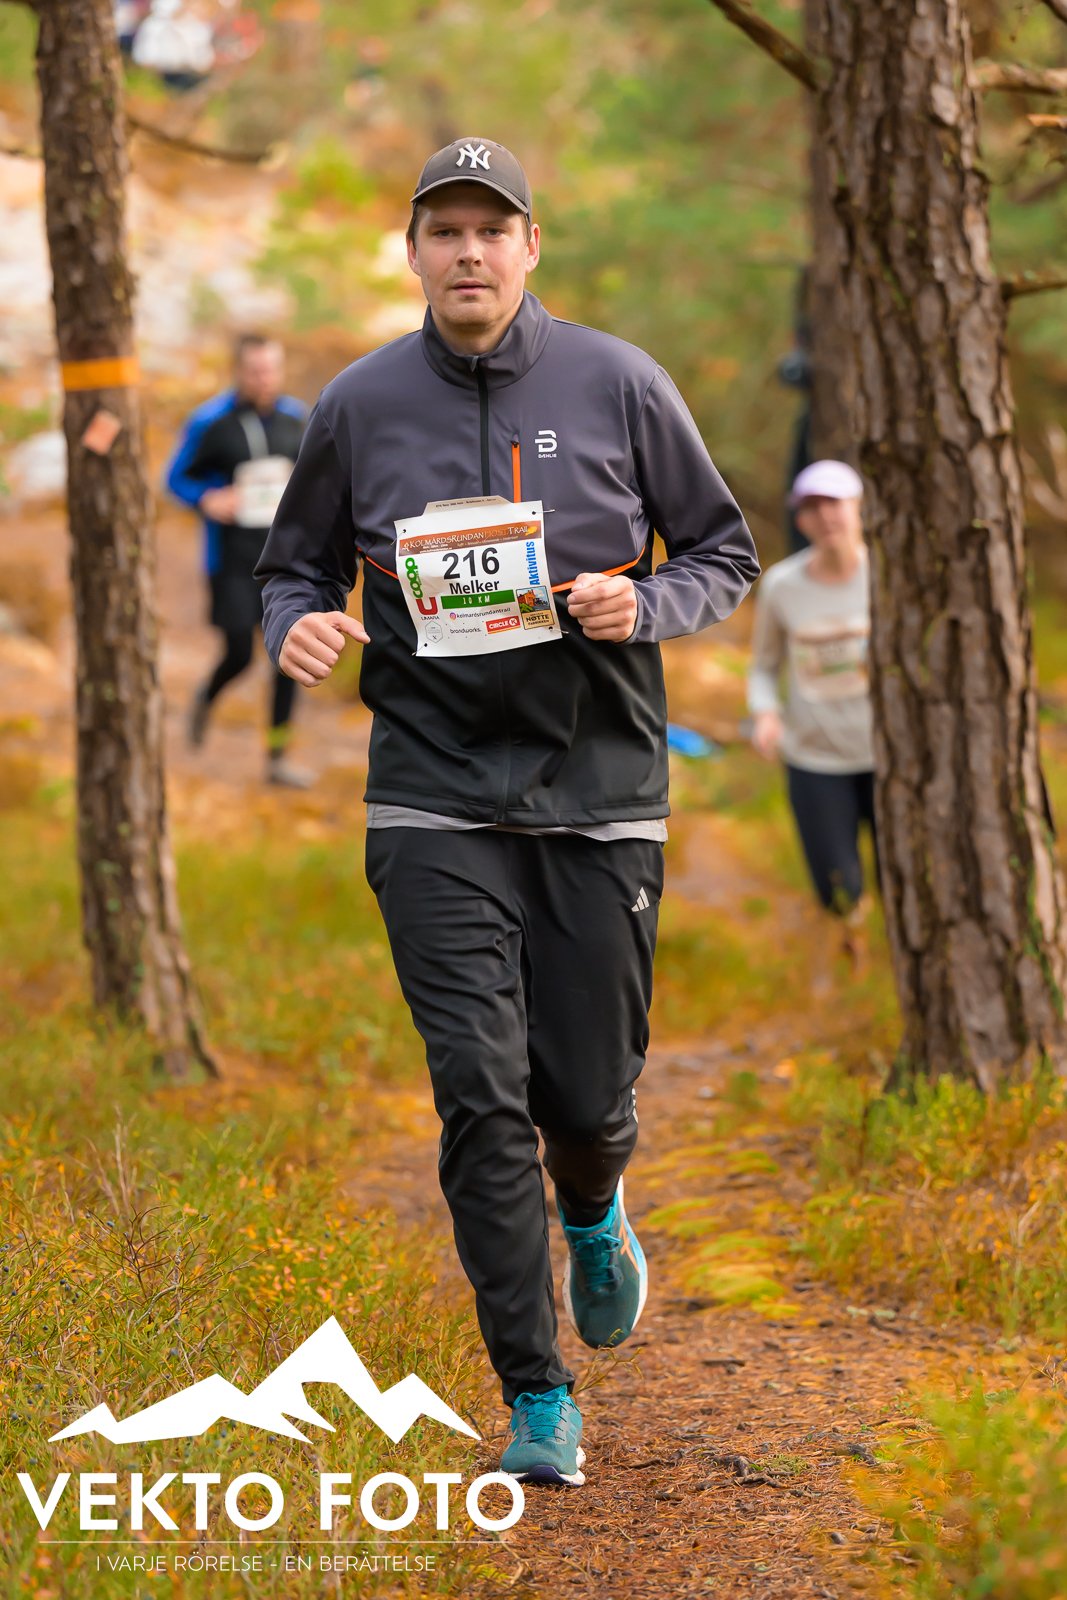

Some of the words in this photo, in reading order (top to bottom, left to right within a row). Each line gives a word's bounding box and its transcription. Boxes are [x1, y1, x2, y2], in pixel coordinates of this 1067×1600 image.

[442, 547, 500, 580] 216
[526, 541, 541, 585] Aktivitus
[405, 557, 423, 598] coop
[449, 579, 500, 595] Melker
[463, 597, 473, 605] 10
[478, 595, 490, 604] KM
[489, 621, 509, 630] CIRCLE
